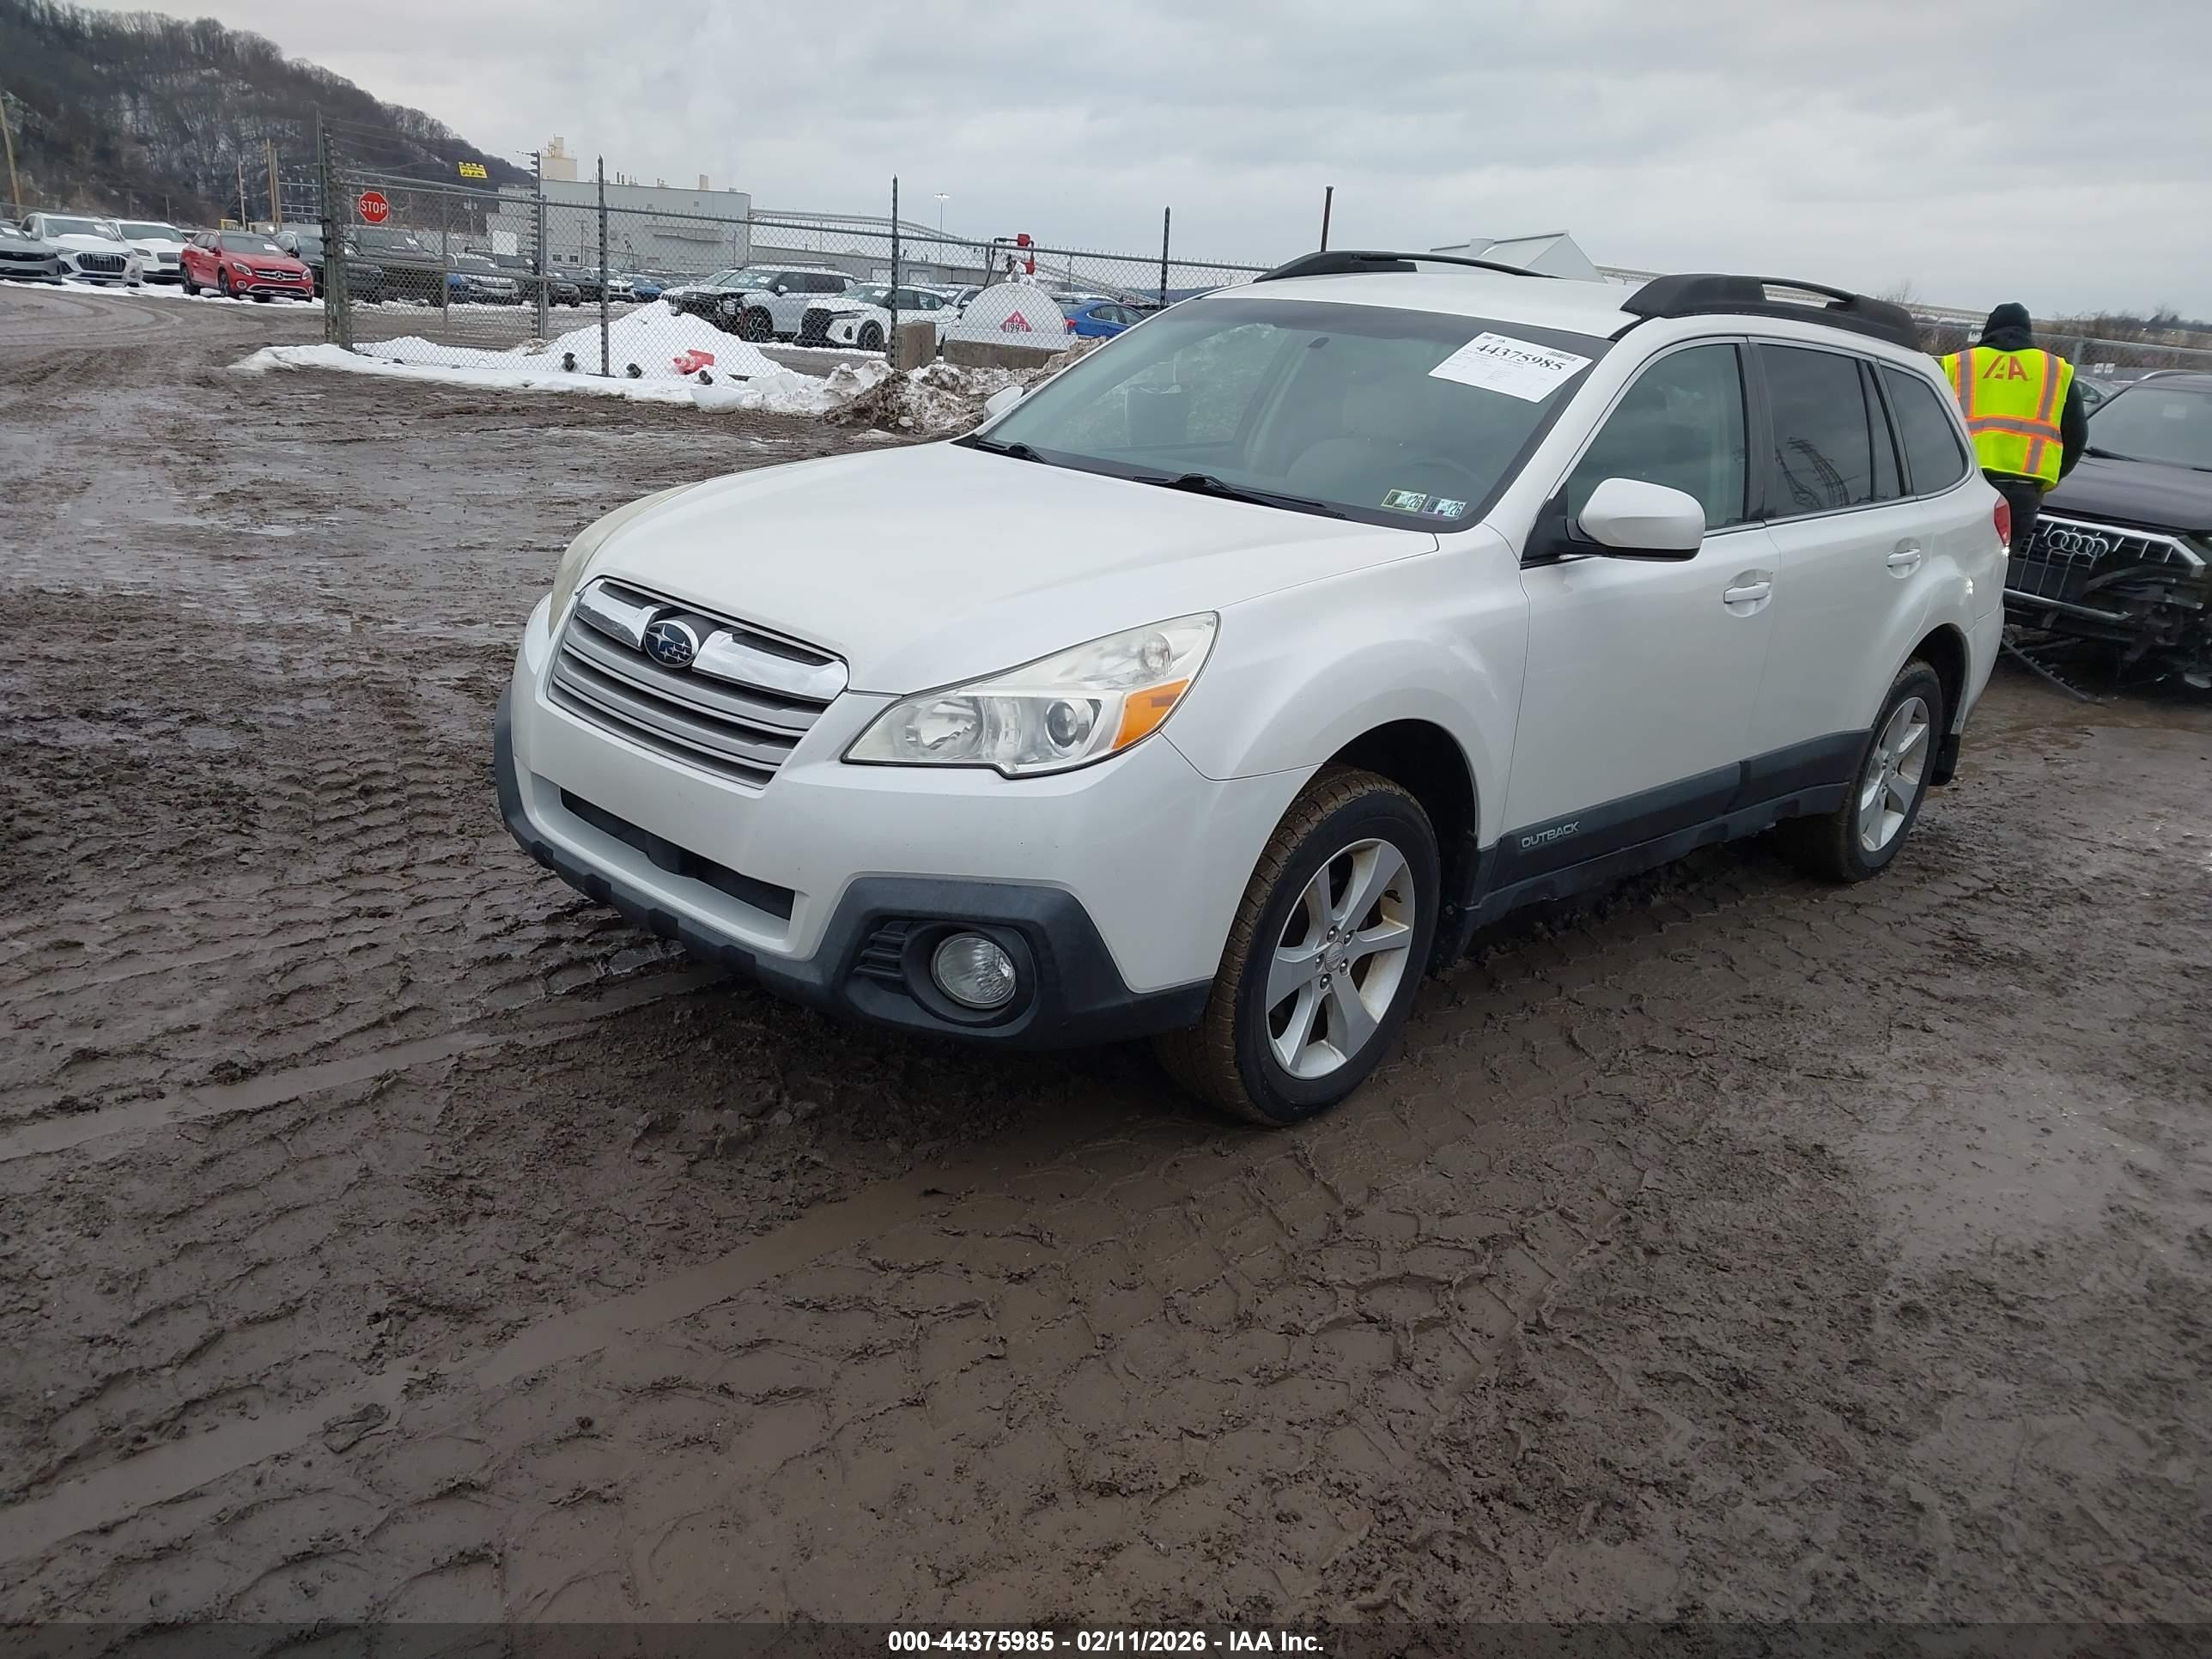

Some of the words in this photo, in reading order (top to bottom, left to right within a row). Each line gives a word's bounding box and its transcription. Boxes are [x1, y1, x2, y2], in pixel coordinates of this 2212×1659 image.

[361, 200, 386, 214] STOP
[1476, 343, 1567, 372] 44375985
[1409, 495, 1424, 509] 26
[1428, 501, 1438, 513] 9
[1449, 501, 1464, 515] 26
[1521, 821, 1580, 848] OUTBACK
